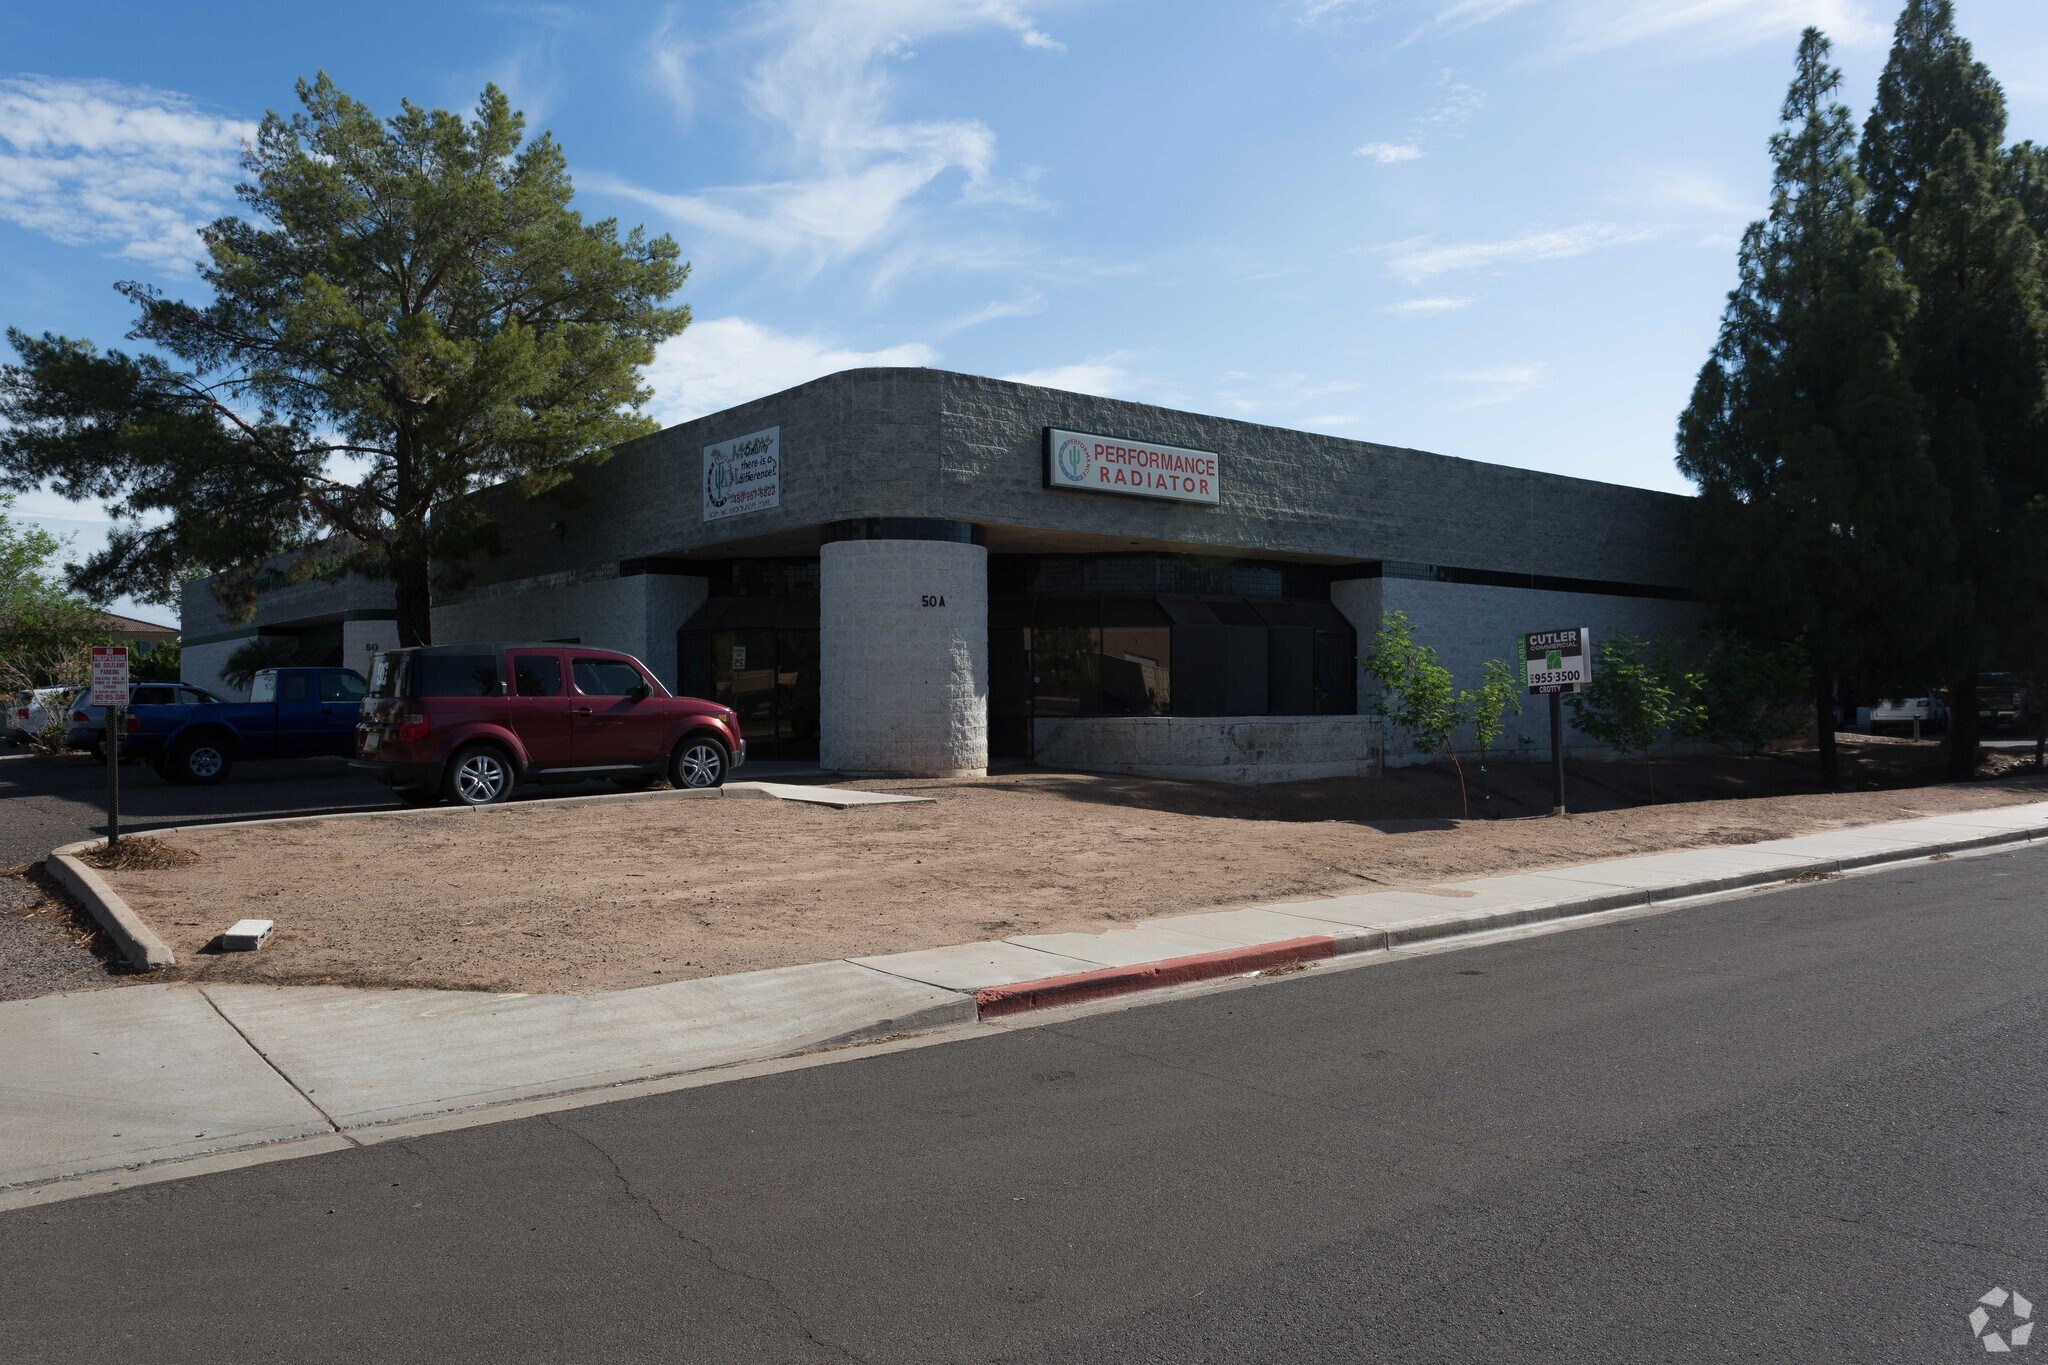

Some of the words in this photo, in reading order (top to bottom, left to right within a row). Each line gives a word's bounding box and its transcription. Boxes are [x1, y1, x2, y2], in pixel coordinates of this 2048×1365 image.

[741, 459, 758, 470] there
[760, 455, 766, 465] is
[1094, 443, 1216, 477] PERFORMANCE
[1099, 466, 1210, 496] RADIATOR
[1529, 631, 1577, 646] CUTLER
[1530, 641, 1578, 651] COMMERCIAL
[366, 643, 379, 651] 50
[1517, 638, 1527, 684] AVAILABLE
[1539, 685, 1561, 694] CROTTY
